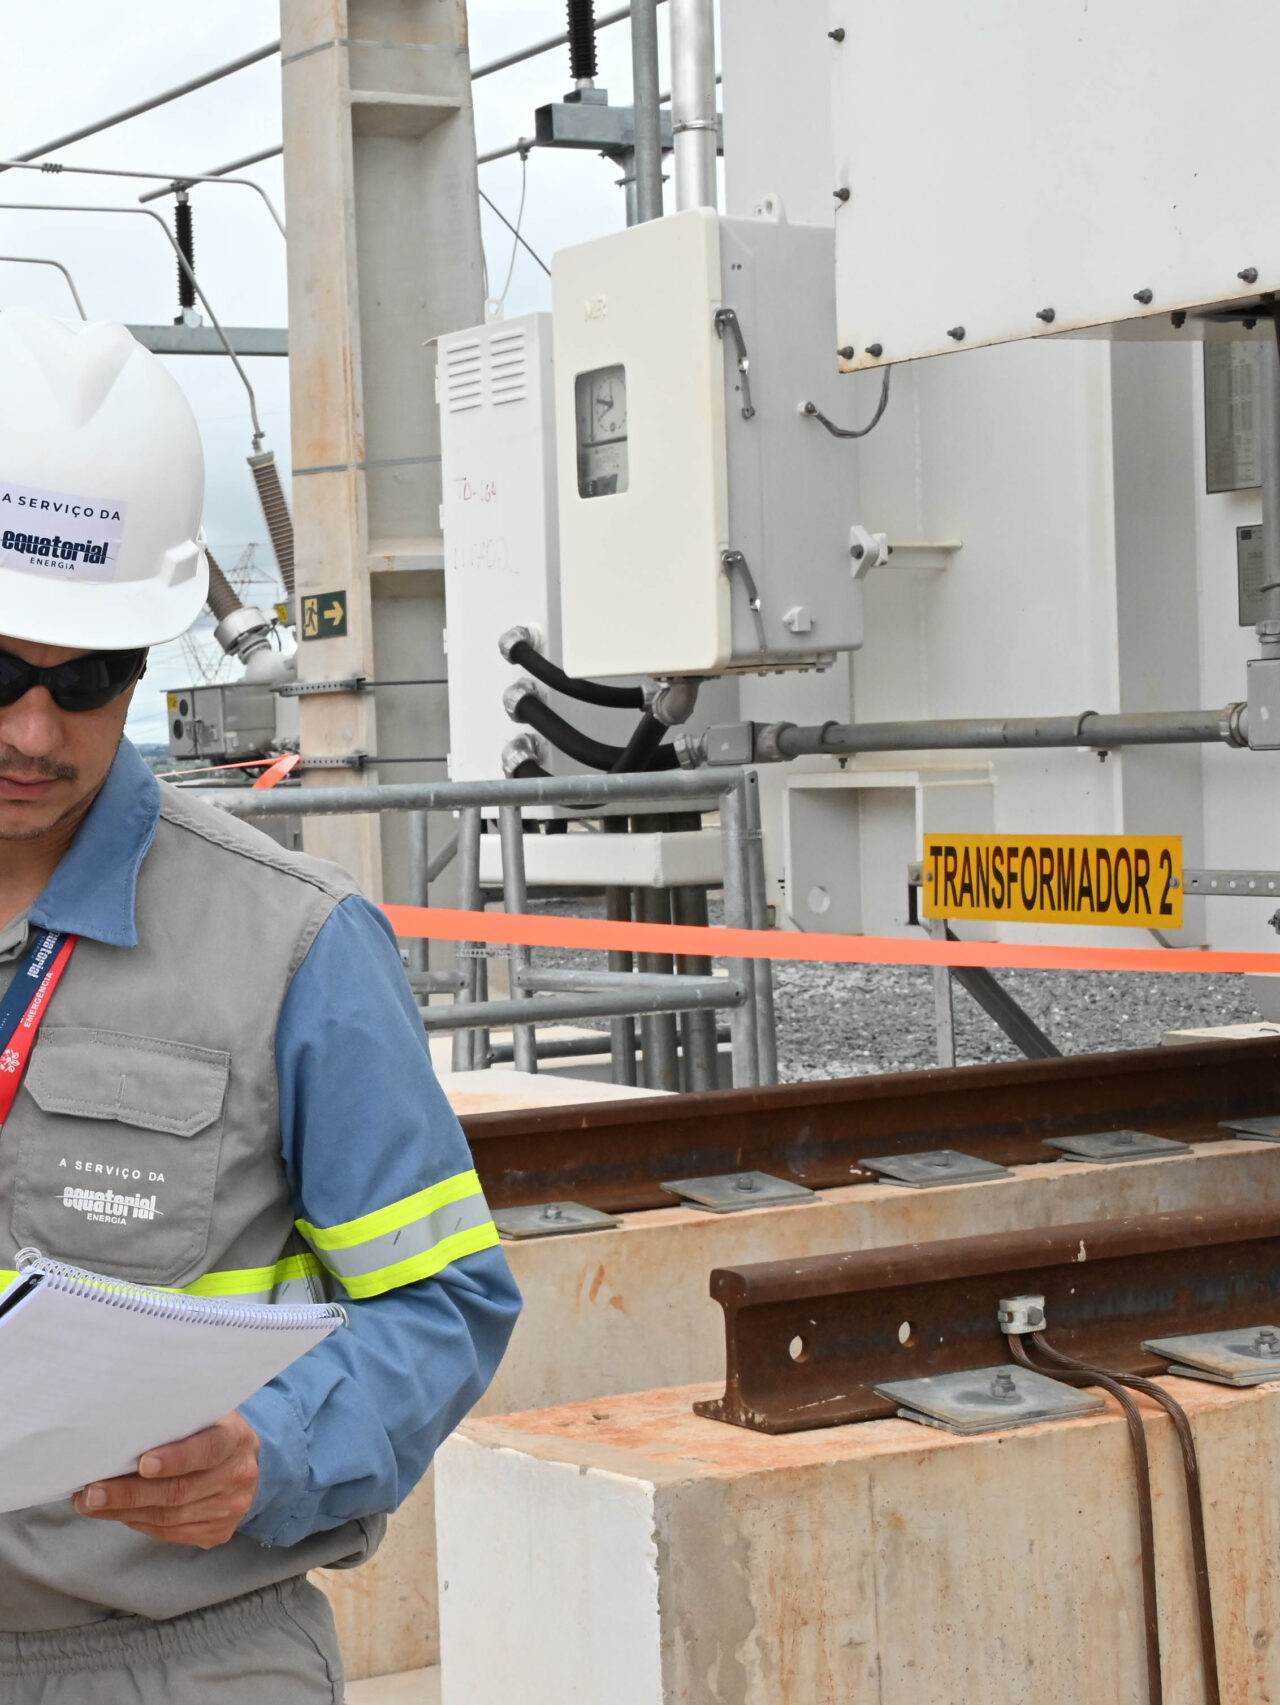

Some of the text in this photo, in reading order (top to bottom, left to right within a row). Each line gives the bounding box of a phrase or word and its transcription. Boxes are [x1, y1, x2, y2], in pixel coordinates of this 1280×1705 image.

[2, 493, 121, 521] A SERVIÇO DA
[2, 530, 109, 565] equatorial
[930, 845, 1174, 916] TRANSFORMADOR 2
[59, 1158, 165, 1182] A SERVIÇO DA
[63, 1186, 156, 1220] equatorial
[87, 1213, 126, 1225] ENERGIA
